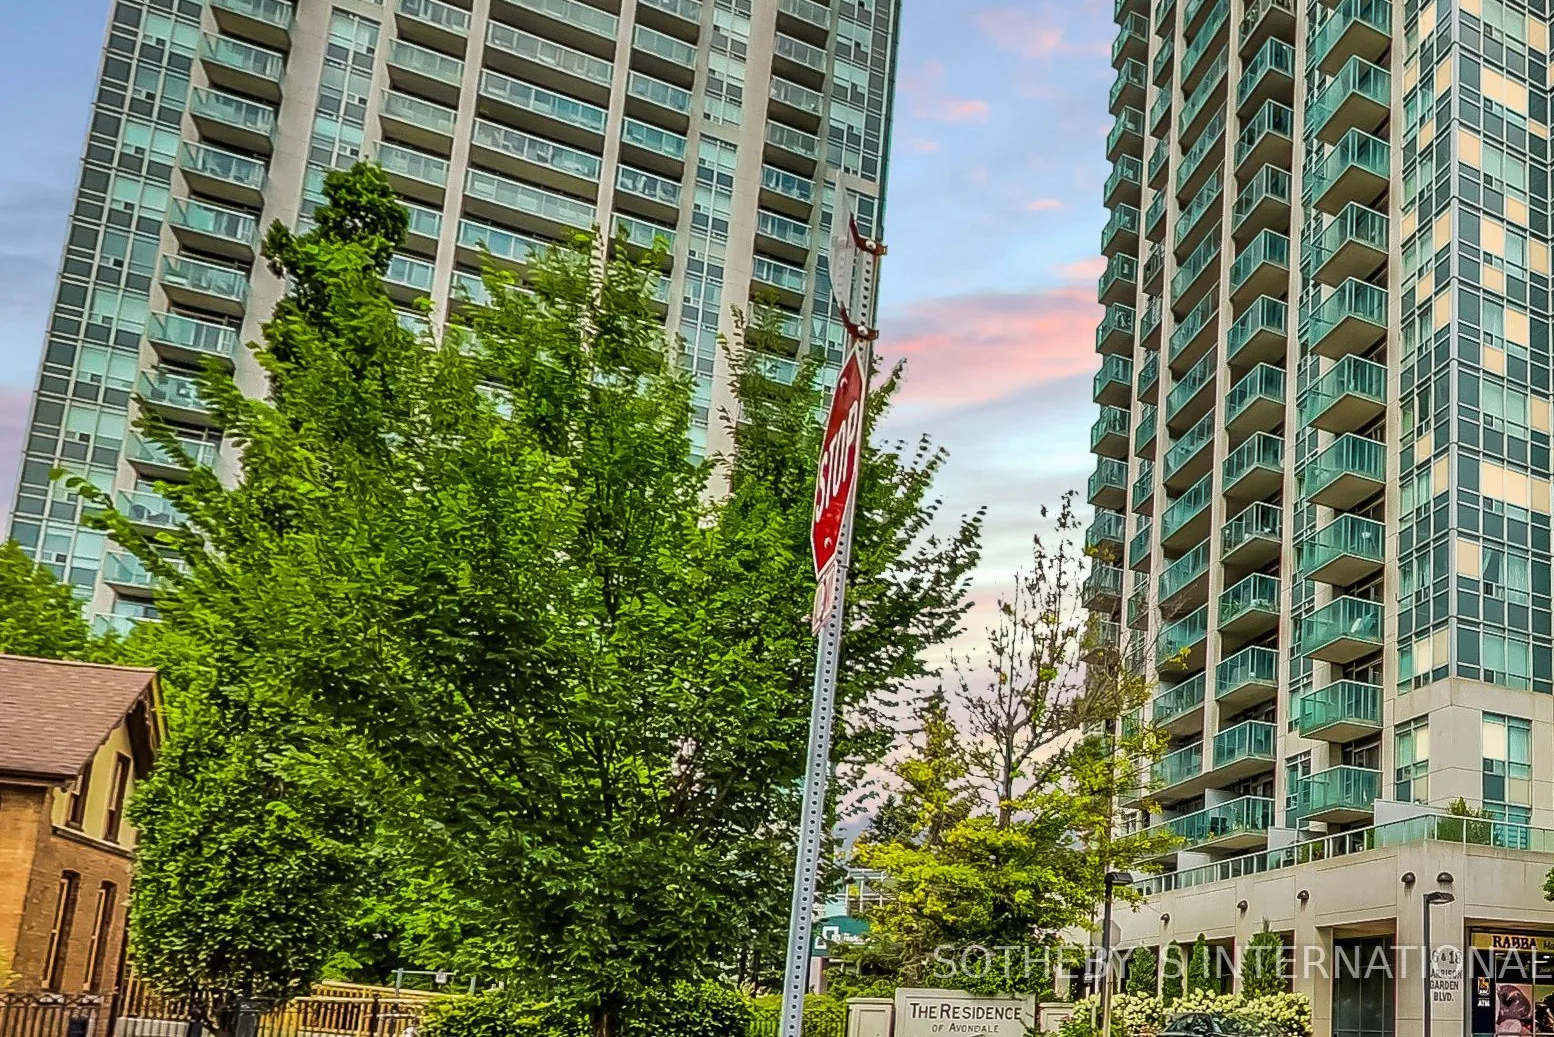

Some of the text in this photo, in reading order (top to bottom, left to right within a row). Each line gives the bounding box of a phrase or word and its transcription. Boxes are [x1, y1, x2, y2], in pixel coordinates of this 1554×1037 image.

[815, 400, 859, 524] STOP
[1492, 935, 1537, 950] RABBA
[1429, 980, 1459, 991] GARDEN
[1433, 991, 1455, 1002] BLVD.
[909, 1002, 1022, 1020] THE RESIDENCE
[931, 1023, 999, 1033] OF AVONDALE
